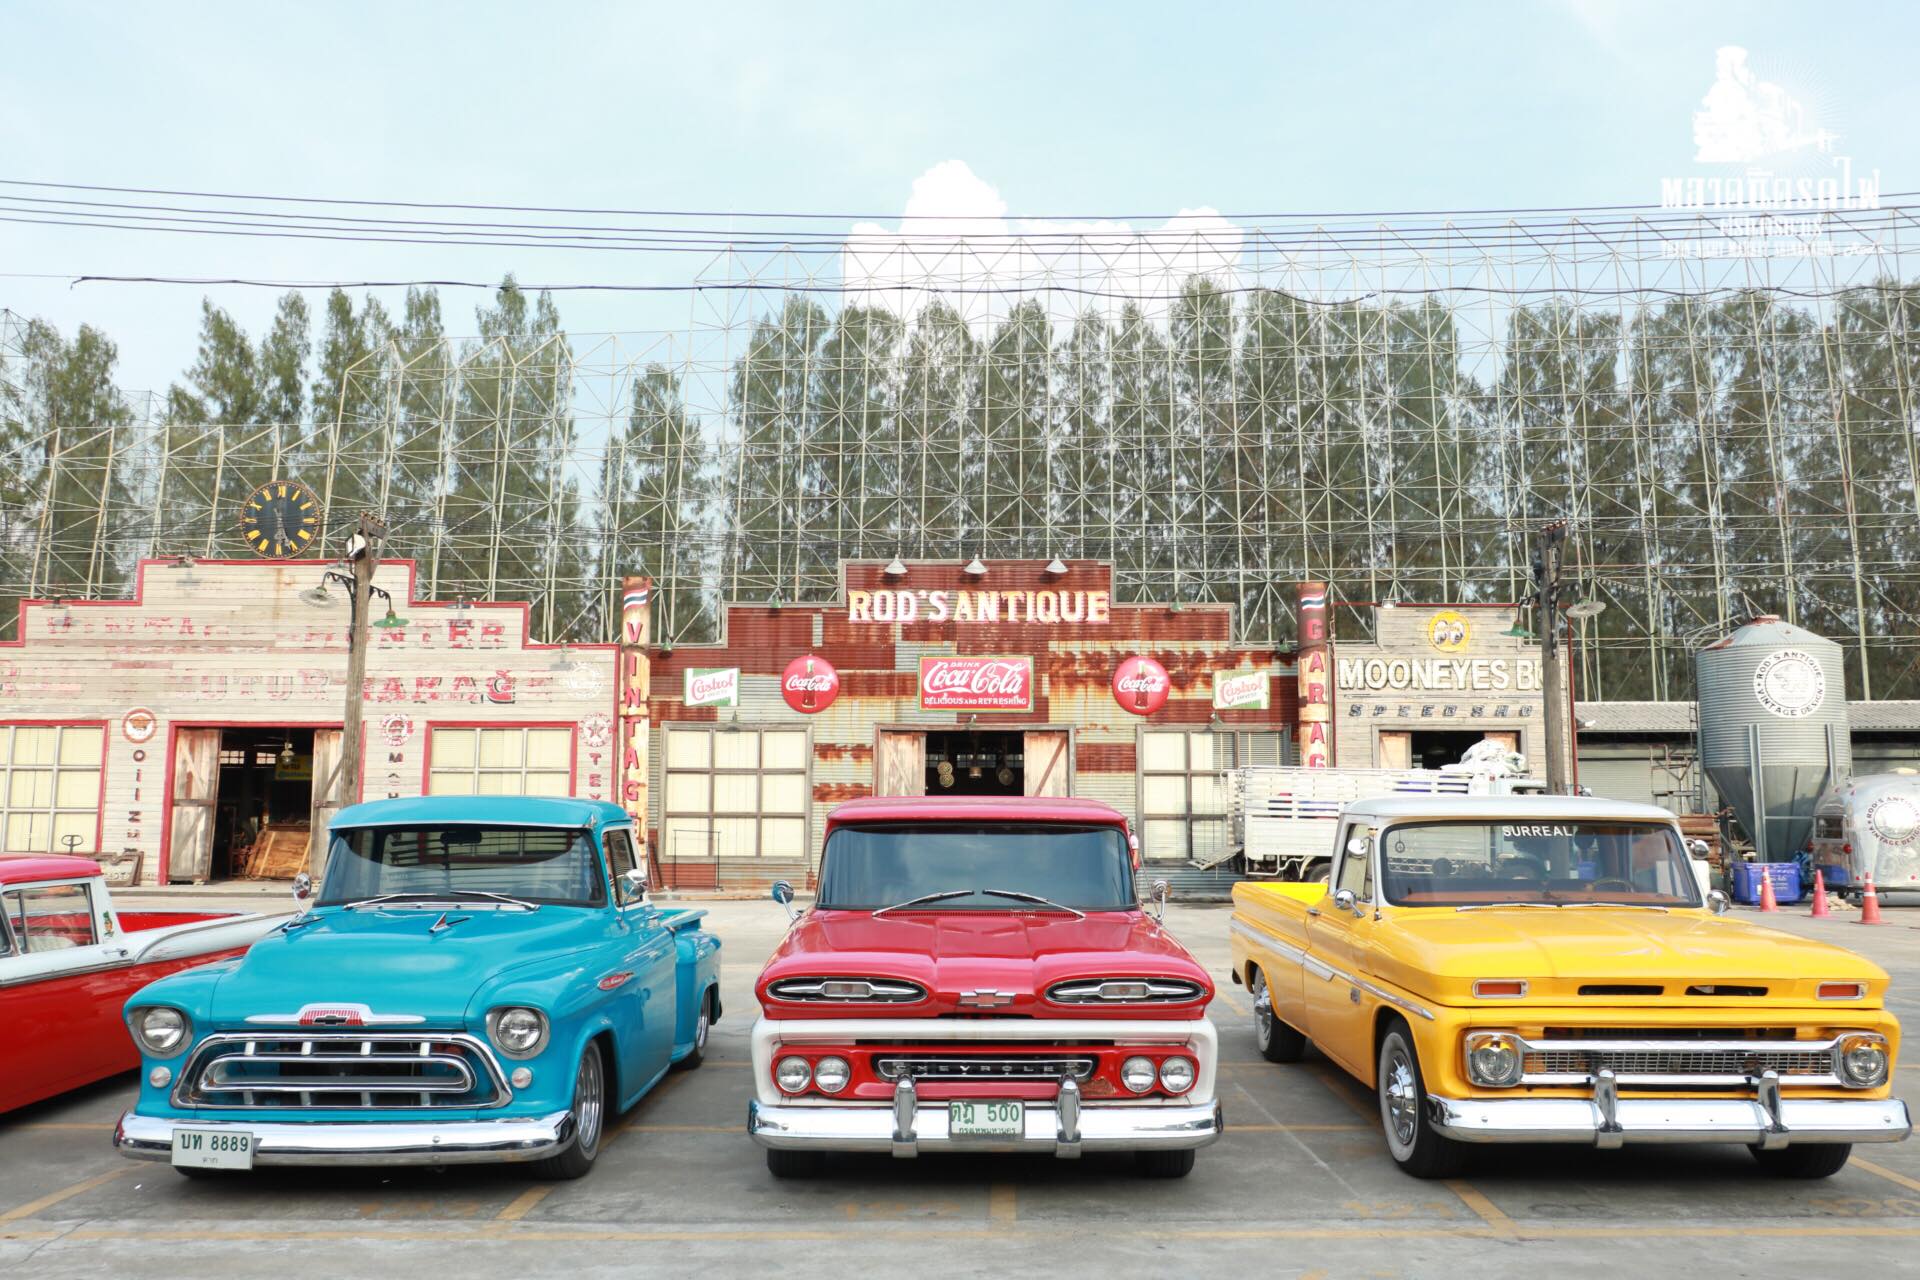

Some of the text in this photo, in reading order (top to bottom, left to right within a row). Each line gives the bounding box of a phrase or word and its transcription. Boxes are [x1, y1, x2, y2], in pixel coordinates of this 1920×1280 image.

[848, 590, 1110, 624] ROD'S ANTIQUE
[1338, 658, 1510, 690] MOONEYES
[1756, 651, 1822, 680] ROD'S ANTIQUE
[691, 672, 734, 701] Castrol
[1220, 675, 1264, 704] Castrol
[1307, 618, 1325, 768] GARAG
[924, 697, 964, 705] DELICIOUS
[978, 697, 1027, 705] REFRESHING
[1470, 704, 1534, 718] SHO
[1757, 688, 1823, 716] VINTAGE DESIGN
[1502, 824, 1573, 838] SURREAL
[896, 1064, 1081, 1074] CHEVROLET
[987, 1103, 1020, 1122] 500
[210, 1135, 249, 1152] 8889
